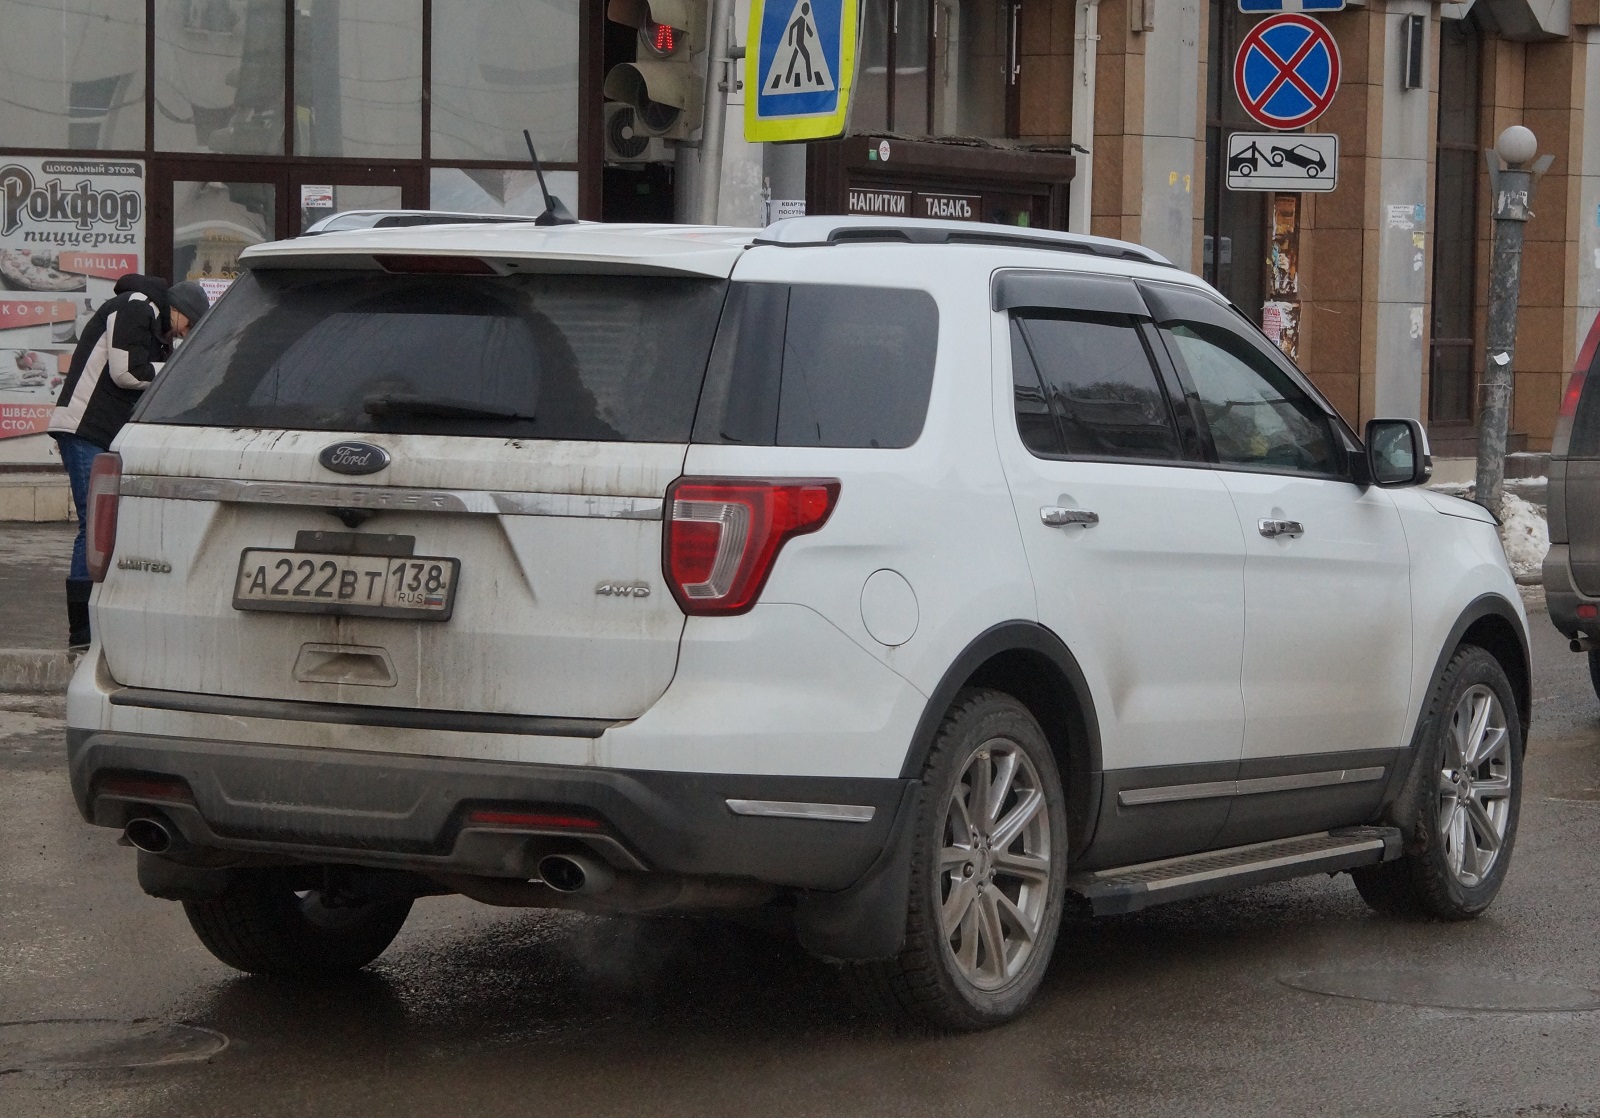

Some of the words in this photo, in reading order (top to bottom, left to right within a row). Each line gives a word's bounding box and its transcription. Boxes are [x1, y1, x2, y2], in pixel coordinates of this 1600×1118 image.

[0, 164, 141, 237] Рокфор
[849, 193, 905, 214] НАПИТКИ
[926, 198, 972, 218] ТАБАКЪ
[24, 231, 137, 247] пиццерия
[73, 258, 129, 269] ПИЦЦА
[2, 304, 58, 316] КОФЕ
[2, 407, 53, 418] ШВЕДСК
[2, 420, 35, 430] СТОЛ
[331, 446, 371, 466] Ford
[248, 557, 382, 600] А222ВТ
[392, 562, 444, 593] 138
[398, 592, 423, 604] RUS
[596, 584, 650, 598] 4WD
